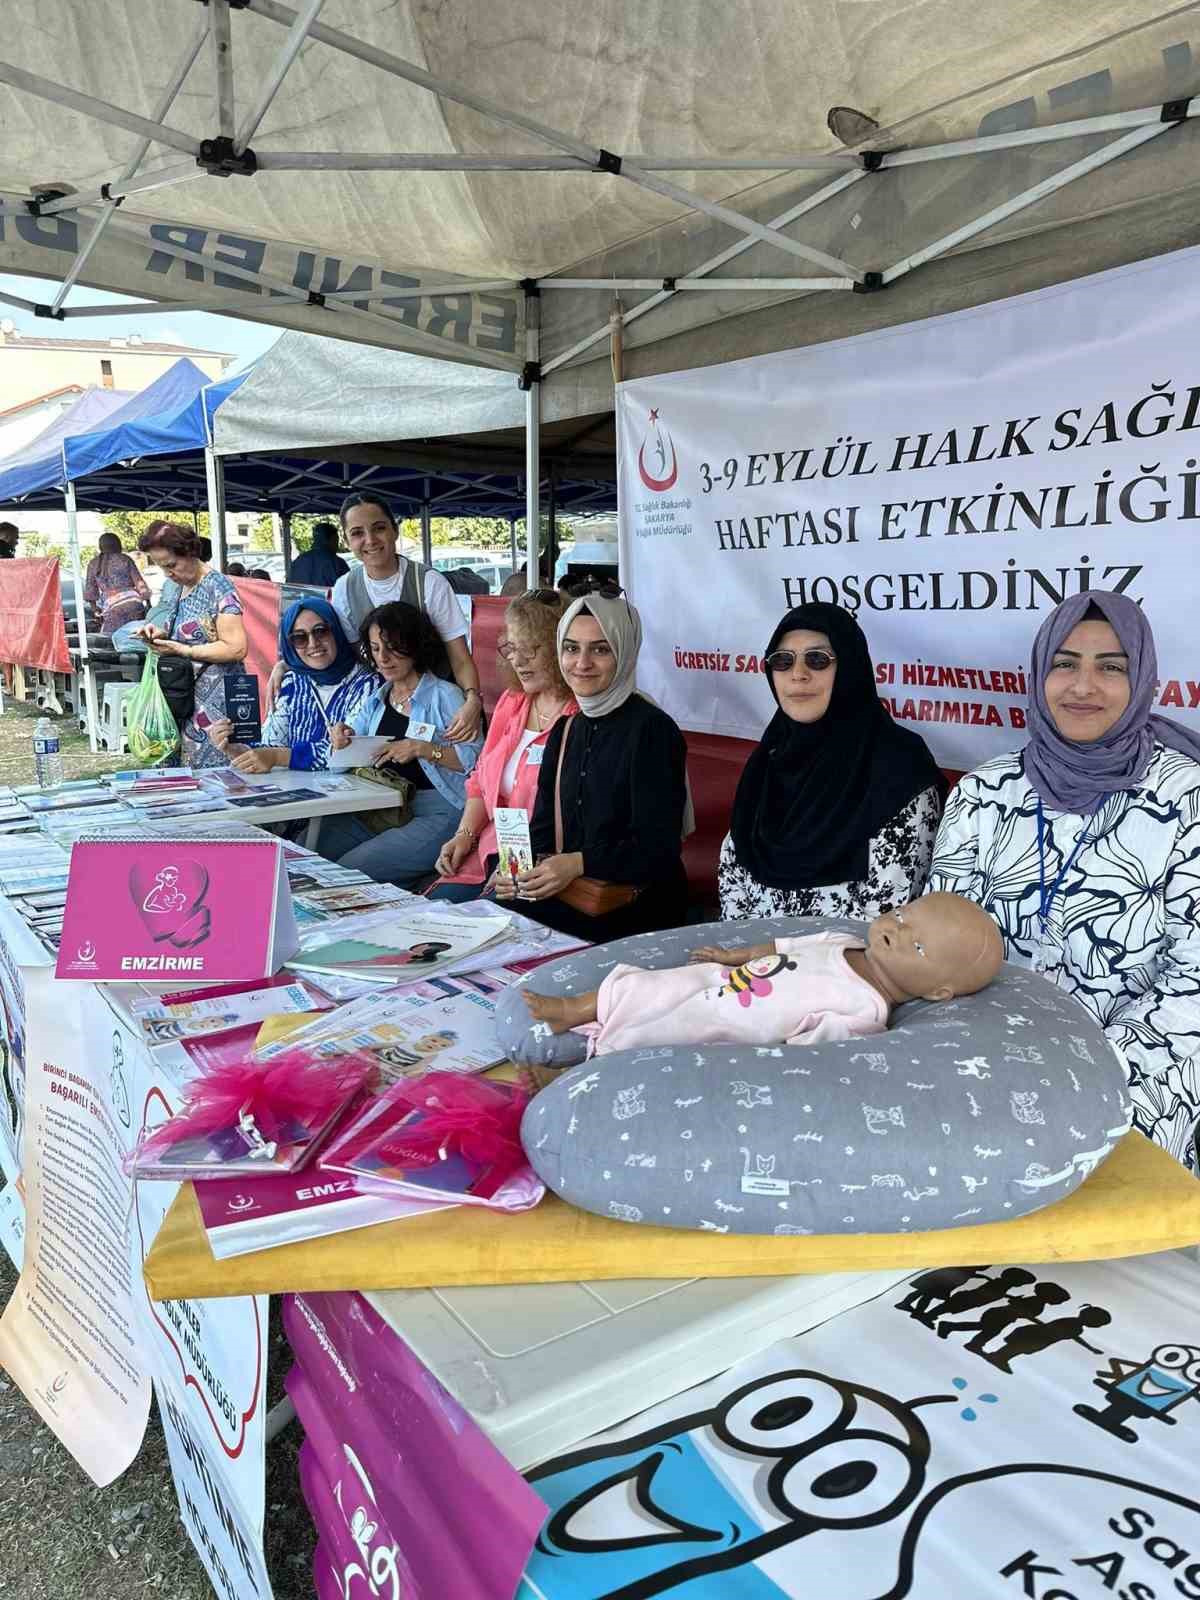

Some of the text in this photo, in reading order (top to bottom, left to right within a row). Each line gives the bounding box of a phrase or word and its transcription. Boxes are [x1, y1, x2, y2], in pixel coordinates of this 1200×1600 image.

[699, 458, 738, 494] 3-9
[744, 435, 878, 487] EYLÜL
[886, 415, 1040, 472] HALK
[714, 505, 861, 551] HAFTASI
[674, 645, 731, 672] ÜCRETSİZ
[121, 953, 205, 971] EMZİRME
[296, 1179, 356, 1201] EMZ
